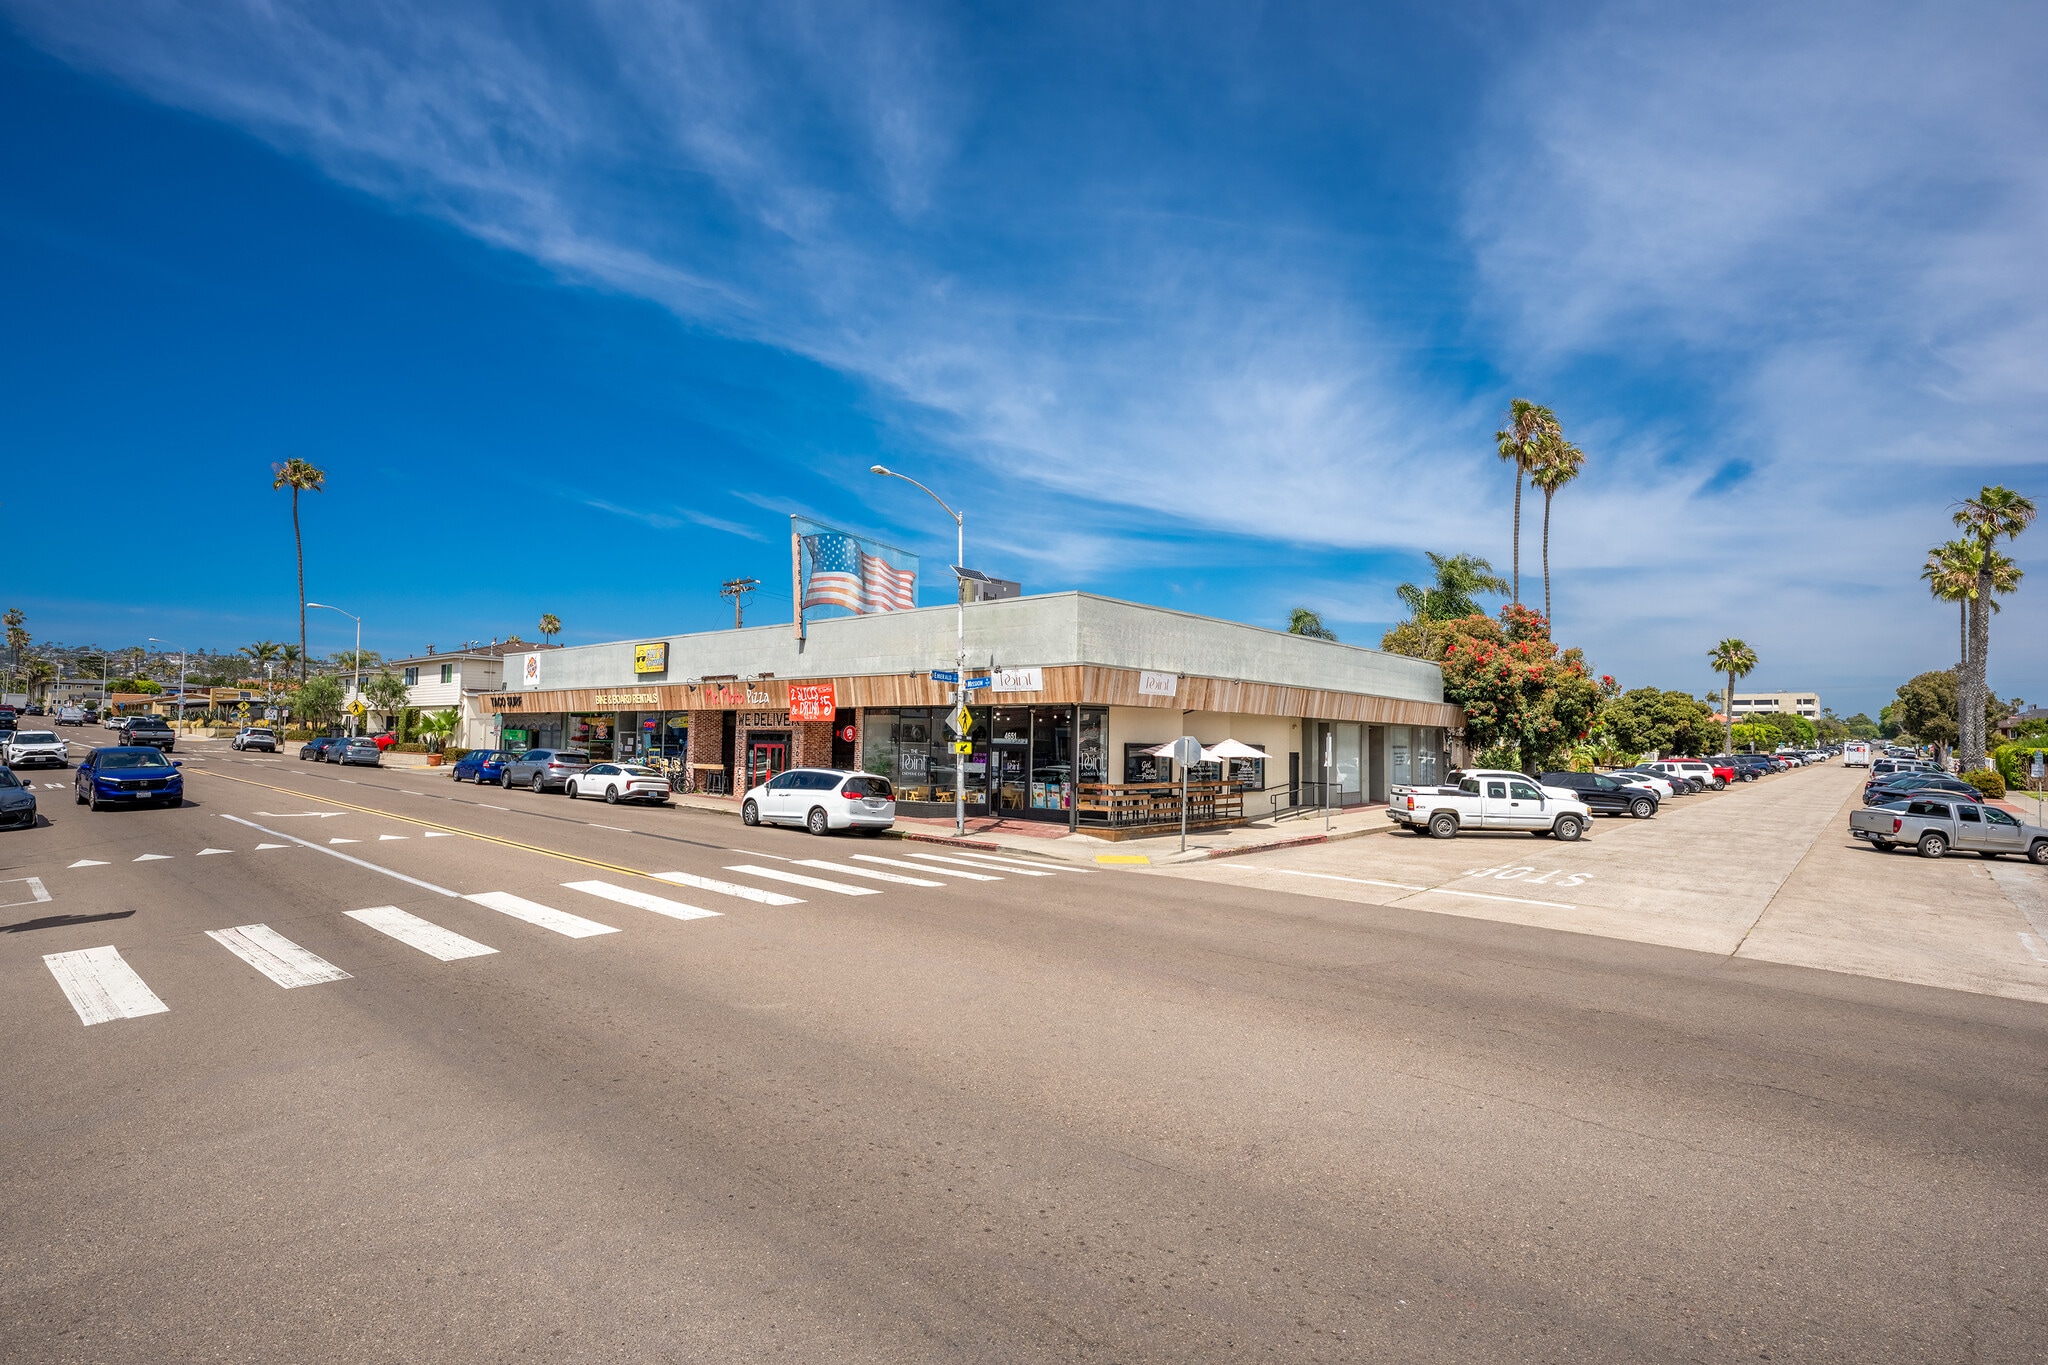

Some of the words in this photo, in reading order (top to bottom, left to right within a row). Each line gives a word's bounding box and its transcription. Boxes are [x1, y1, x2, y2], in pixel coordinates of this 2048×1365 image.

[934, 671, 952, 681] EMERALD
[595, 694, 608, 705] BIKE
[608, 695, 612, 704] &
[613, 694, 632, 705] BOARD
[633, 693, 658, 704] RENTALS
[746, 689, 769, 704] Pizza
[790, 688, 796, 700] 2
[796, 686, 818, 701] SLICES
[490, 697, 506, 708] TACO
[507, 696, 522, 707] SURF
[791, 704, 798, 715] &
[799, 700, 820, 716] DRINK
[737, 712, 751, 726] WE
[1004, 731, 1017, 740] 4651
[901, 753, 929, 771] Point
[1081, 752, 1104, 770] Point
